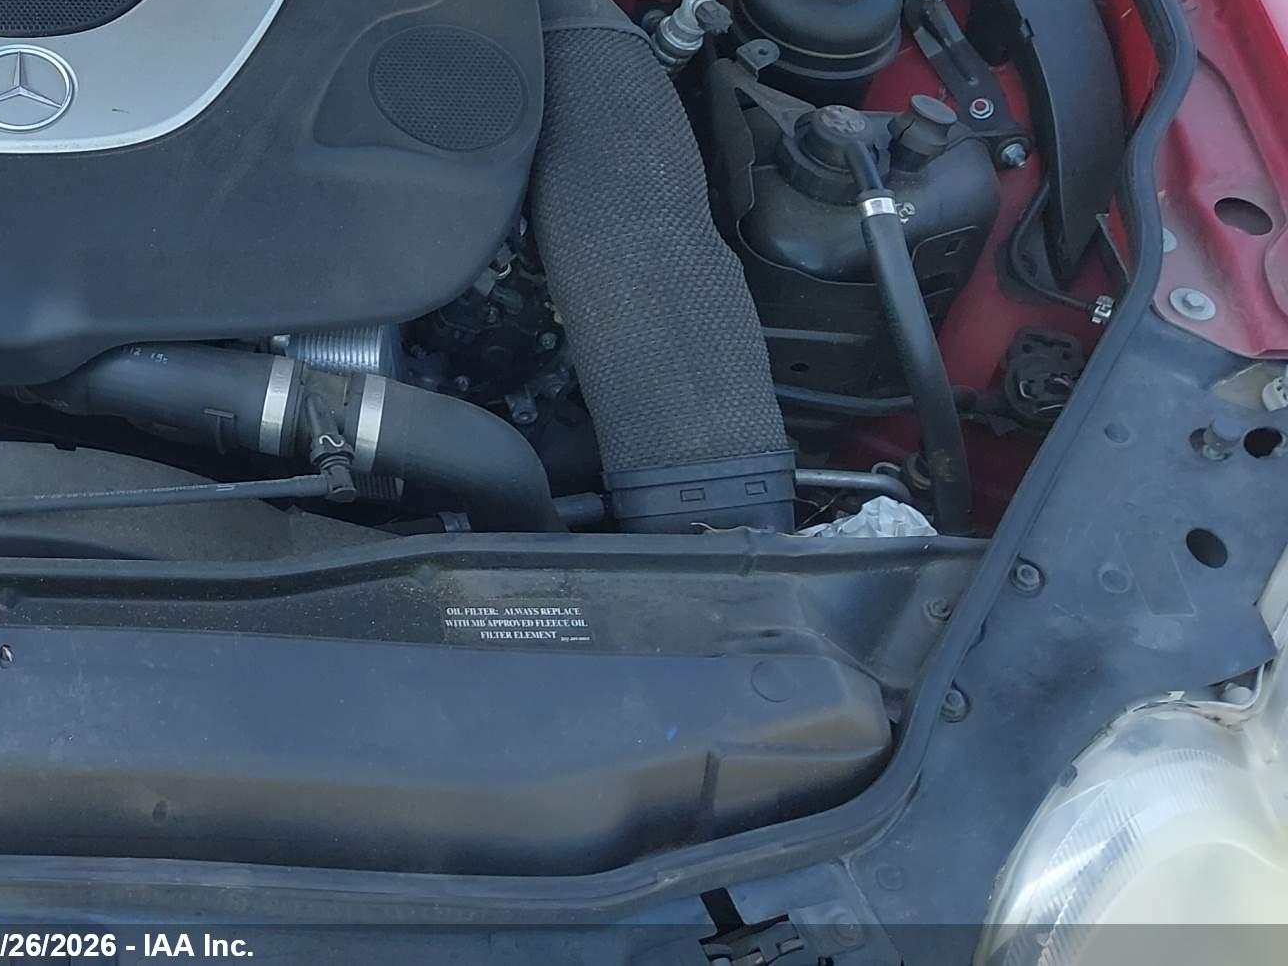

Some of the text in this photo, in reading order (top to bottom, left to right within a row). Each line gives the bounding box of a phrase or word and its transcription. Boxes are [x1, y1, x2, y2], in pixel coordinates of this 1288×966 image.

[446, 607, 581, 616] OIL FILTER: ALWAYS REPLACE
[445, 619, 588, 628] WITH MB APPROVED FLEECE OIL
[480, 631, 512, 639] FILTER
[513, 631, 557, 639] ELEMENT
